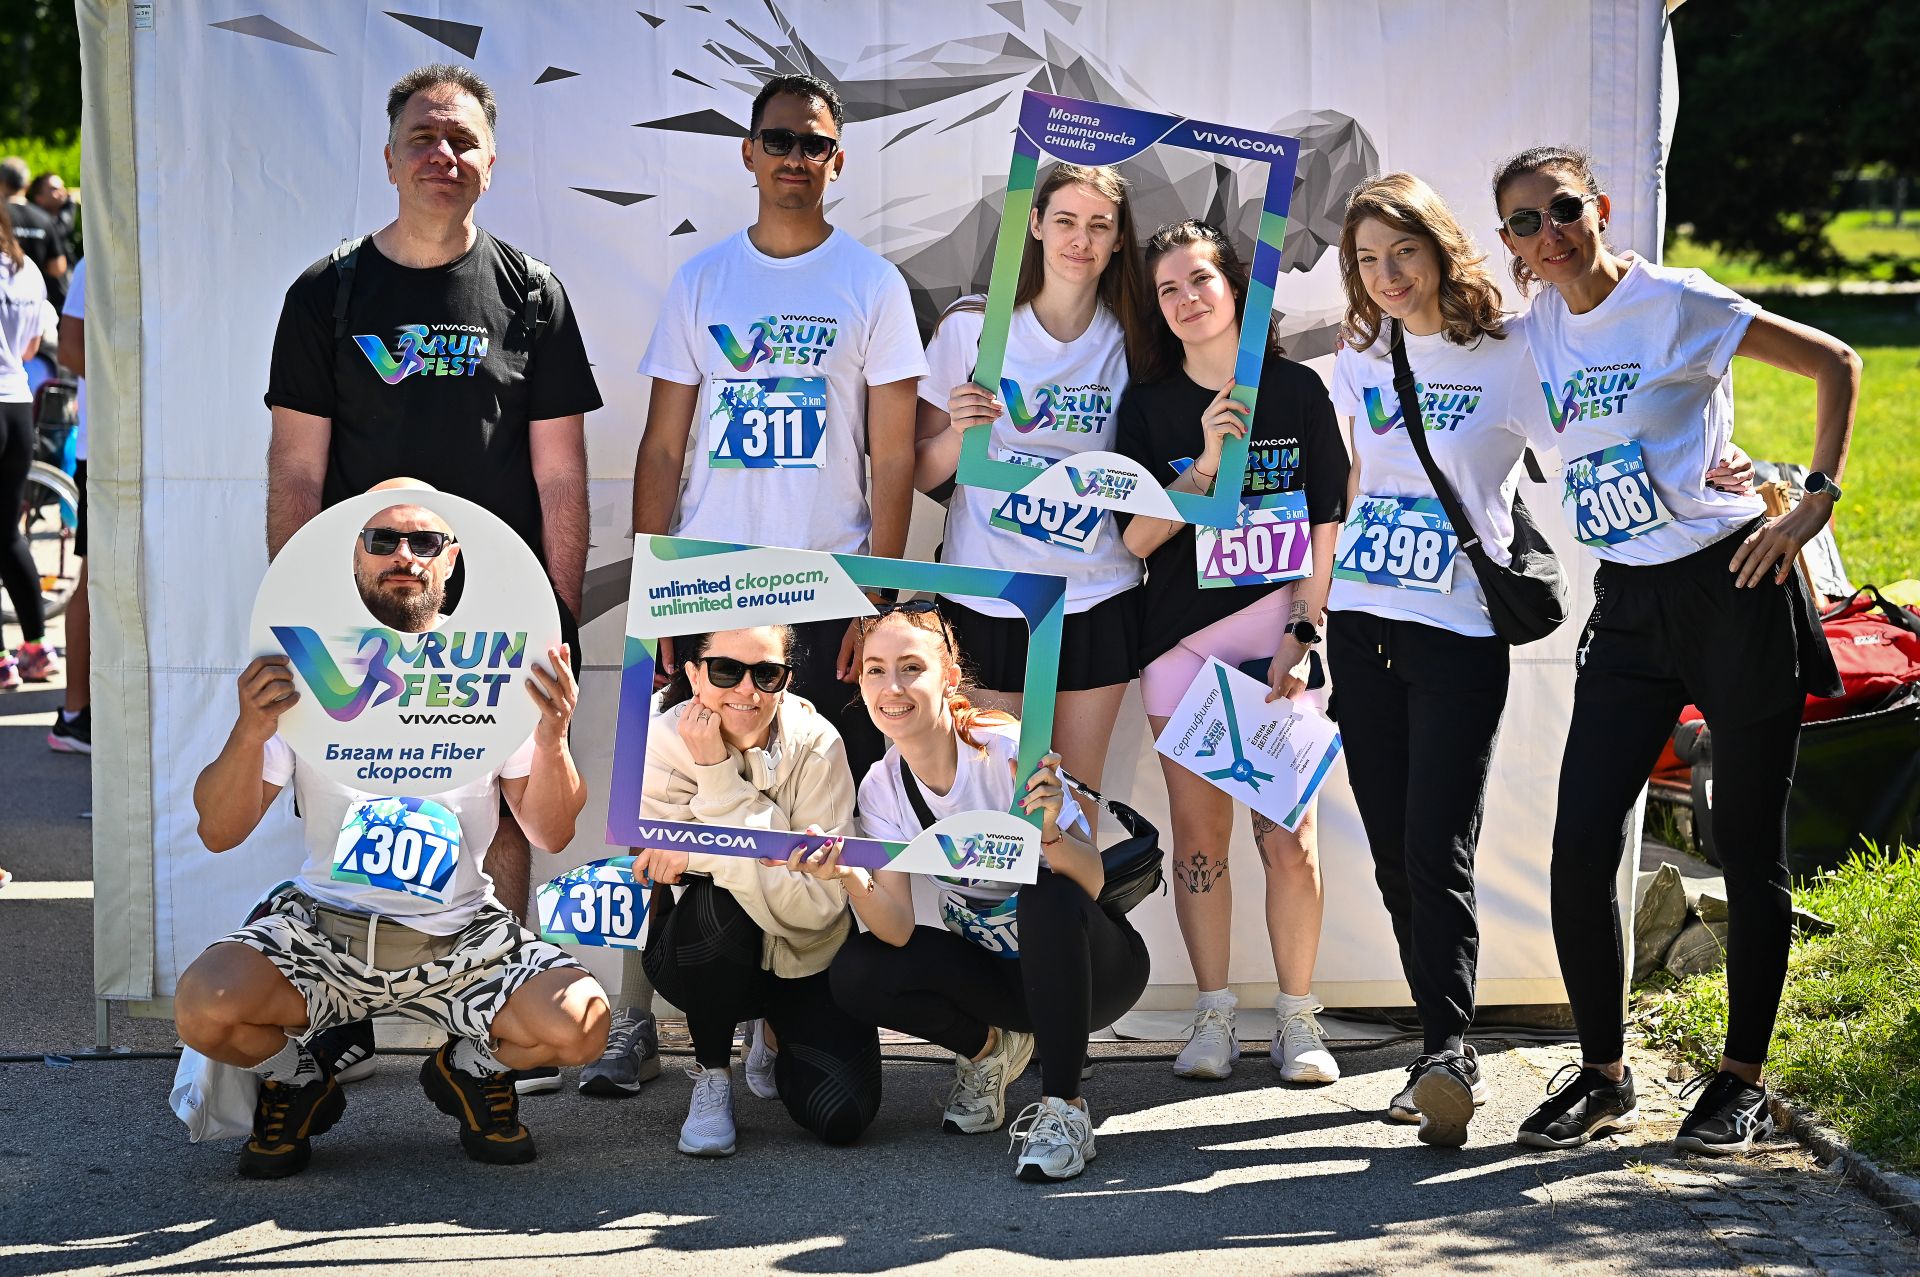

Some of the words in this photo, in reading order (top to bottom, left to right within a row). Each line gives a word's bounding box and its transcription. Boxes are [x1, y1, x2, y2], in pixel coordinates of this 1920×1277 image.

[1048, 107, 1100, 127] Моята
[1044, 134, 1096, 152] снимка
[1046, 122, 1136, 146] шампионска
[1192, 129, 1285, 156] VIVACOM
[431, 324, 488, 334] VIVACOM
[781, 314, 838, 325] VIVACOM
[428, 334, 489, 357] RUN
[777, 325, 838, 348] RUN
[769, 346, 828, 366] FEST
[421, 357, 481, 376] FEST
[1585, 362, 1642, 372] VIVACOM
[1063, 384, 1111, 393] VIVACOM
[1428, 382, 1482, 392] VIVACOM
[1584, 373, 1640, 398] RUN
[802, 397, 807, 405] 3
[809, 397, 821, 406] km
[1062, 394, 1111, 414] RUN
[1420, 392, 1480, 414] RUN
[1578, 394, 1628, 421] FEST
[1052, 414, 1107, 434] FEST
[1422, 413, 1466, 431] EST
[742, 409, 803, 457] 311
[1249, 437, 1299, 447] IVACOM
[1246, 447, 1300, 470] RUN
[1624, 462, 1629, 472] 3
[1105, 474, 1138, 490] RUN
[1106, 468, 1138, 478] VIVACOM
[1097, 487, 1132, 500] FEST
[1286, 511, 1291, 519] 5
[1292, 510, 1304, 518] km
[1580, 475, 1652, 537] 308
[1435, 520, 1441, 529] 3
[1221, 522, 1297, 576] 507
[1360, 525, 1440, 580] 398
[649, 575, 731, 599] unlimited
[735, 570, 829, 591] скорост,
[651, 593, 733, 617] unlimited
[736, 589, 815, 608] емоции
[412, 631, 528, 669] RUN
[398, 673, 511, 708] FEST
[398, 714, 497, 725] VIVACOM
[1173, 688, 1219, 757] Сертификат
[1209, 719, 1223, 741] RUN
[1215, 725, 1227, 746] FEST
[325, 744, 394, 761] Бягам
[399, 748, 424, 760] на
[430, 743, 486, 760] Fiber
[356, 762, 453, 784] скорост
[638, 826, 758, 850] VIVACOM
[986, 833, 1024, 841] VIVACOM
[362, 825, 448, 887] 307
[982, 840, 1025, 857] RUN
[976, 855, 1016, 870] FEST
[569, 883, 633, 937] 313
